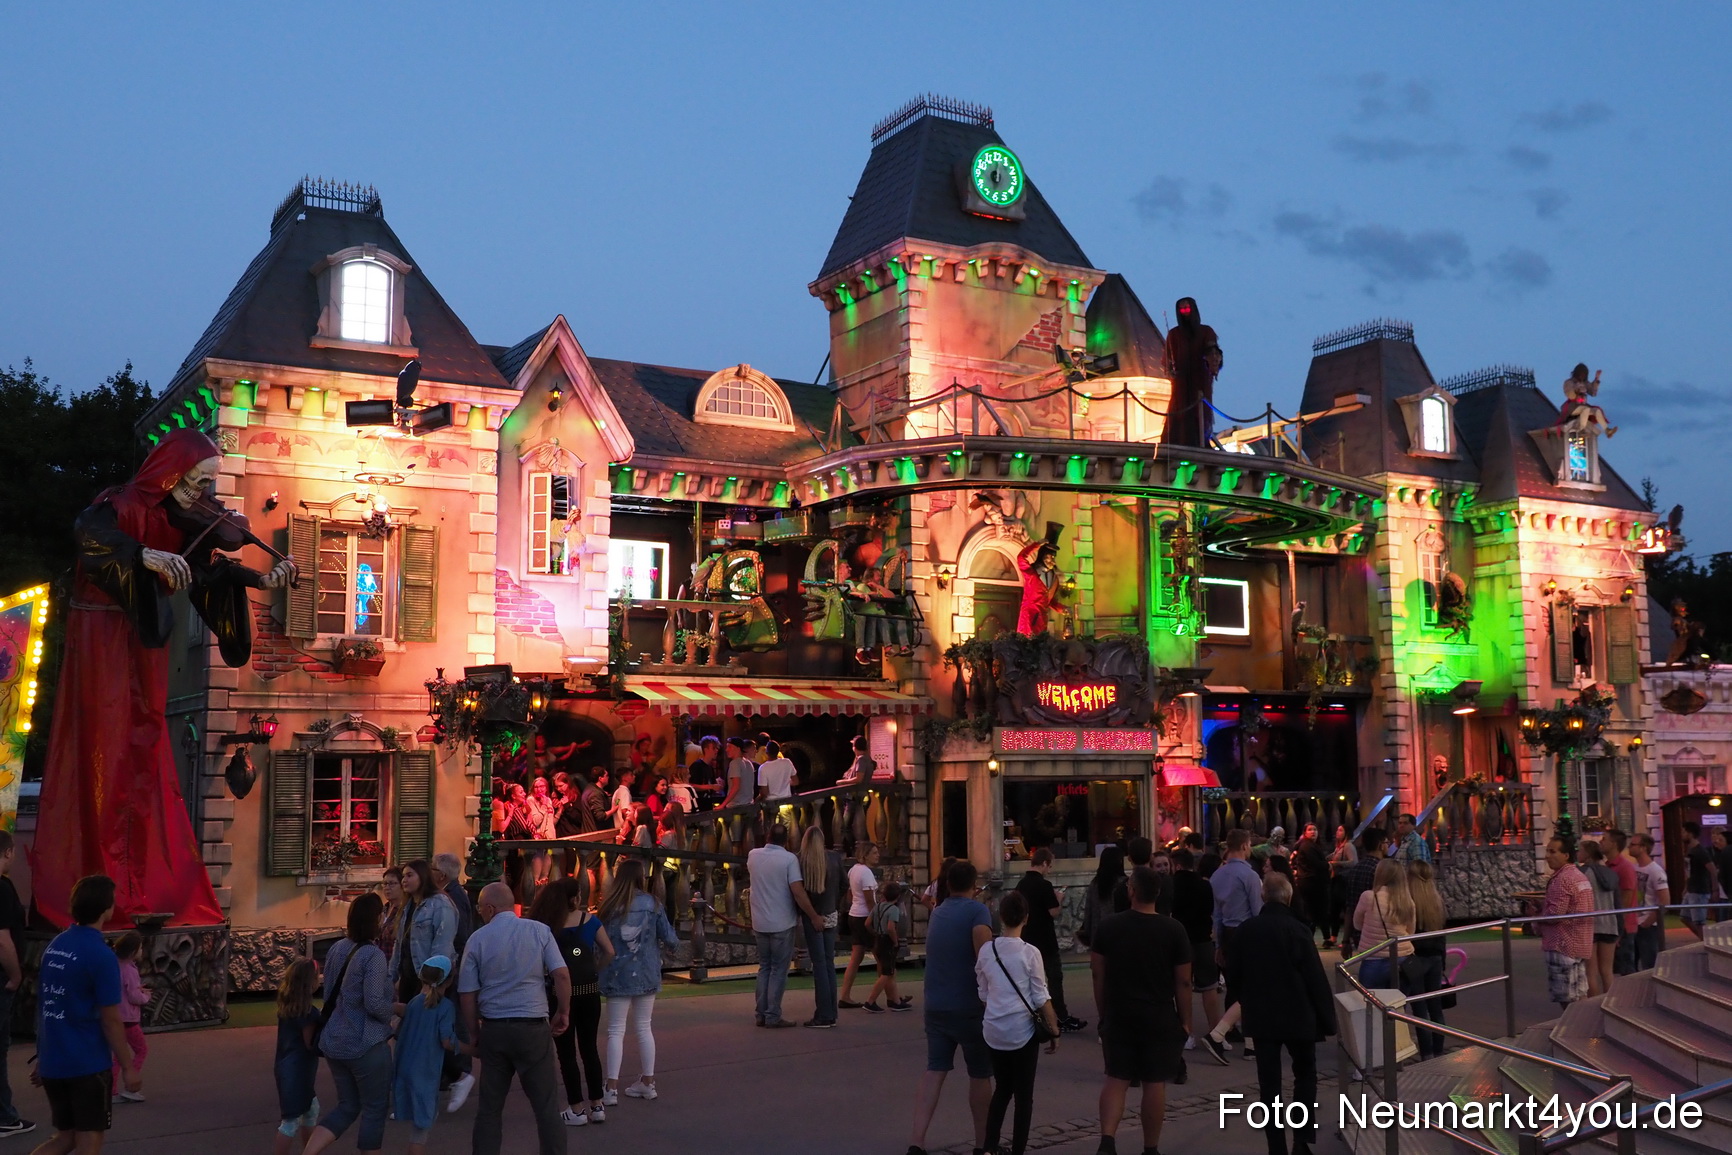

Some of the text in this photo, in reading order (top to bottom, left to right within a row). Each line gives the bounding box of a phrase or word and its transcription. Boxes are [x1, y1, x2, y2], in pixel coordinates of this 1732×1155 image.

[985, 153, 993, 164] 11
[993, 152, 1003, 162] 12
[1003, 157, 1009, 166] 1
[978, 159, 987, 170] 10
[975, 169, 981, 177] 9
[1009, 166, 1016, 176] 2
[1011, 176, 1017, 186] 3
[984, 188, 990, 196] 7
[1008, 186, 1015, 195] 4
[992, 192, 999, 201] 6
[1001, 192, 1008, 201] 5
[1037, 682, 1116, 713] WELCOME
[1001, 730, 1152, 751] HAUNTED MANSION
